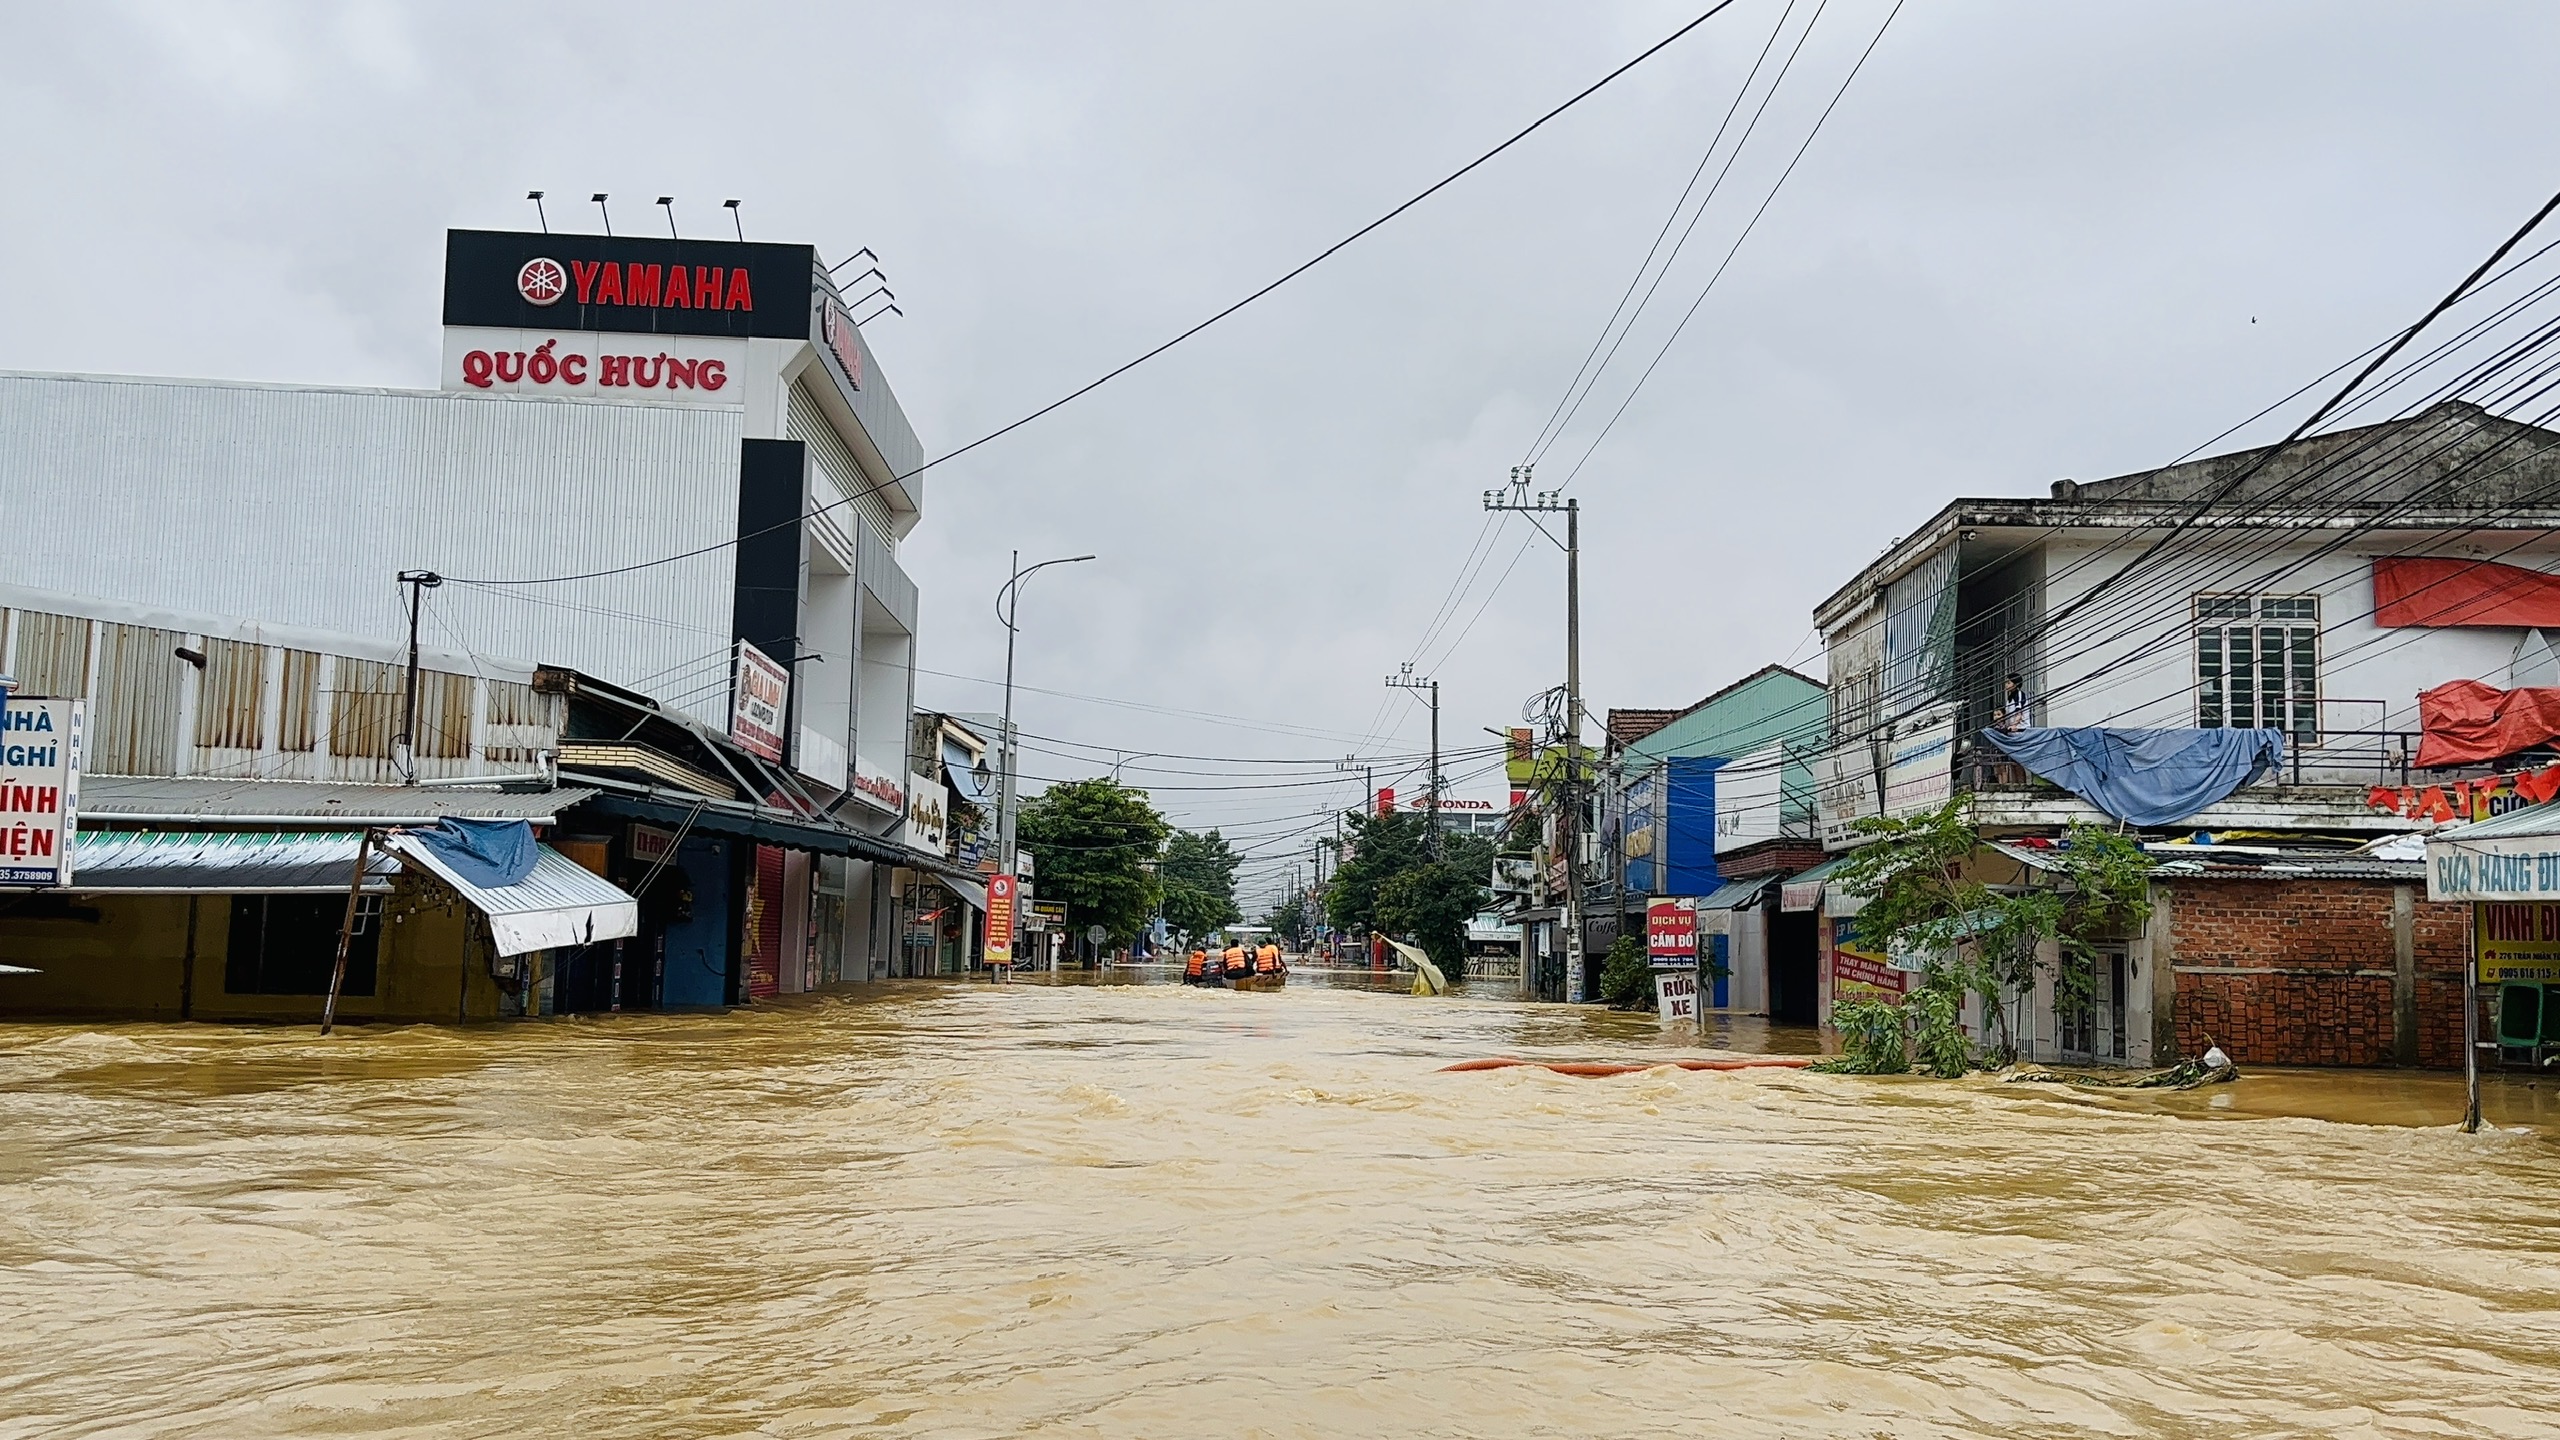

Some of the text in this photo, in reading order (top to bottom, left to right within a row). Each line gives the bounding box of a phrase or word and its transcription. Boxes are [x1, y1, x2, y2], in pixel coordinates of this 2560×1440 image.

[570, 260, 753, 312] YAMAHA
[463, 338, 727, 391] QUỐC HƯNG
[64, 713, 82, 873] NHÀ NGHỈ
[2437, 845, 2471, 893] CỬA
[2477, 845, 2531, 892] HÀNG
[1588, 920, 1617, 935] Coffe
[1651, 915, 1692, 928] DỊCH VỤ
[1650, 930, 1694, 948] CẦM ĐỒ
[1840, 956, 1859, 968] THAY
[1859, 960, 1879, 972] MÀN
[1662, 975, 1696, 998] RỬA
[1851, 969, 1876, 983] CHÍNH
[1877, 975, 1899, 988] HÃNG
[1670, 999, 1692, 1016] XE
